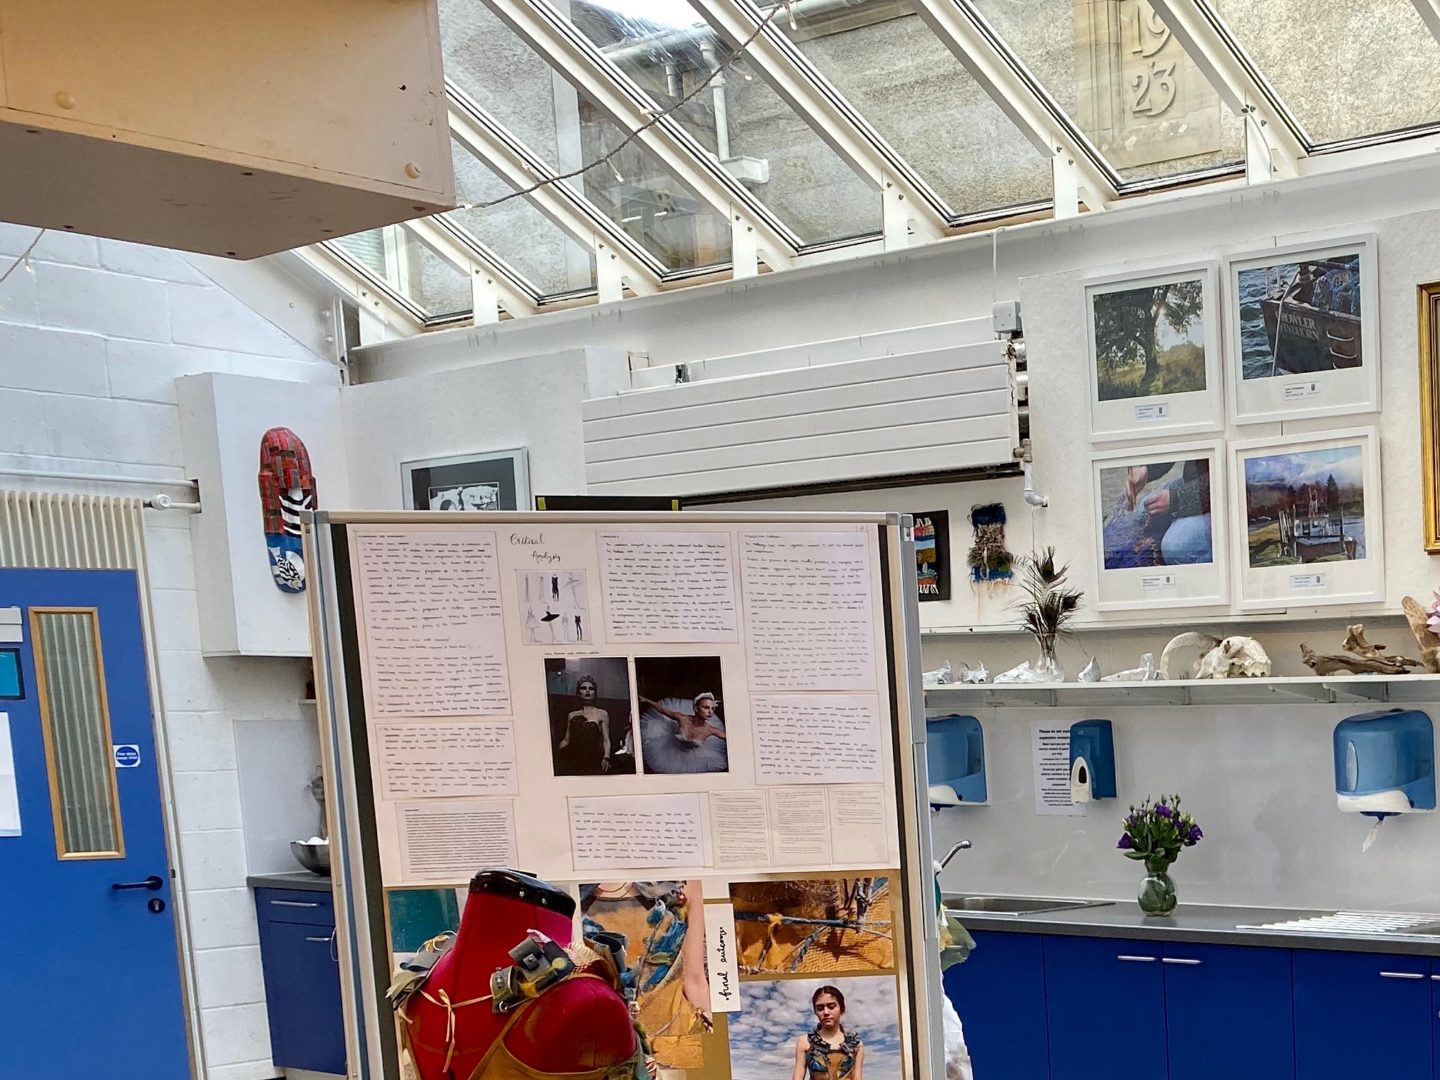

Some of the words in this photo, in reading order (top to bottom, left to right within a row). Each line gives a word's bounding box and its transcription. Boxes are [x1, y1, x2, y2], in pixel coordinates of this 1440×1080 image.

[1131, 60, 1177, 118] 23
[509, 532, 545, 546] Critical
[717, 971, 732, 998] final
